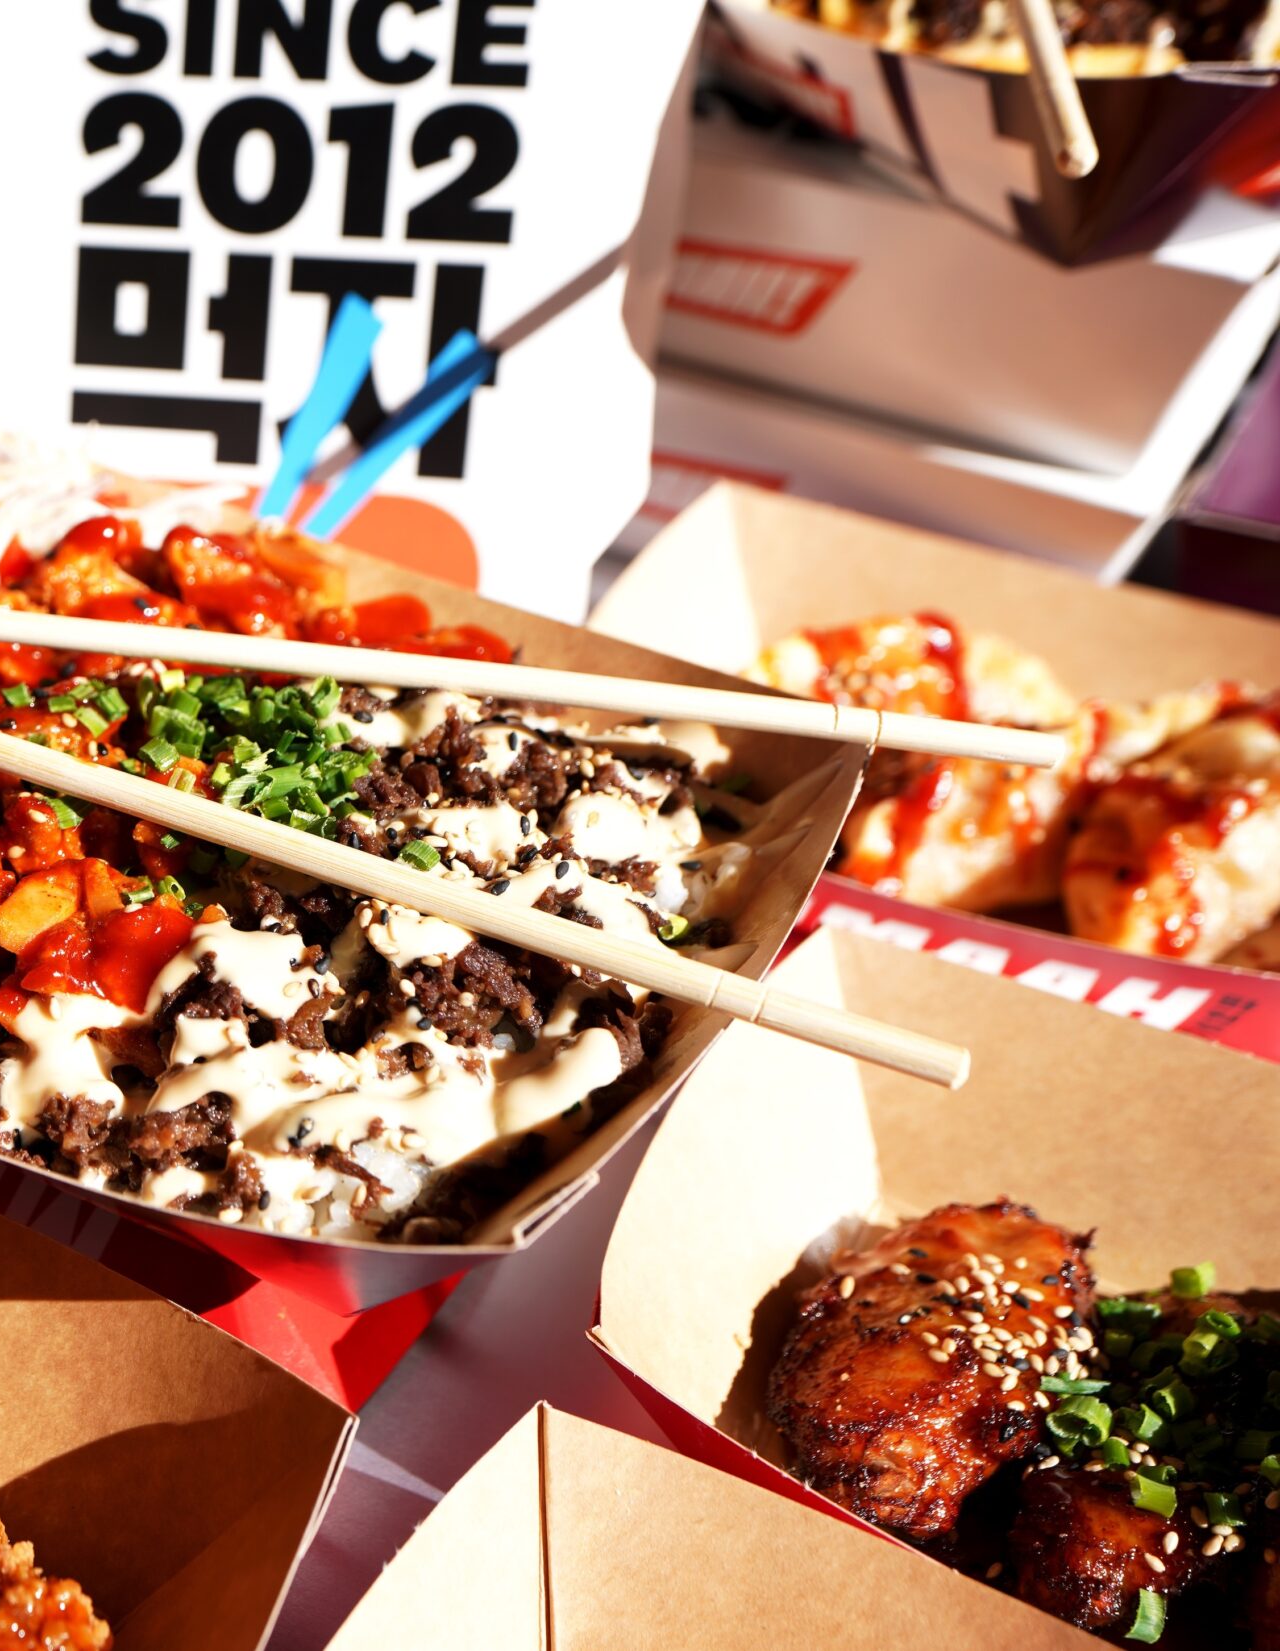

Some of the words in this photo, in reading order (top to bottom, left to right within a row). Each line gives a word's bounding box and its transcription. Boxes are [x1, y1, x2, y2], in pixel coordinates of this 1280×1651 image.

[86, 0, 536, 86] SINCE
[79, 90, 519, 243] 2012
[796, 896, 1213, 1033] MAAH
